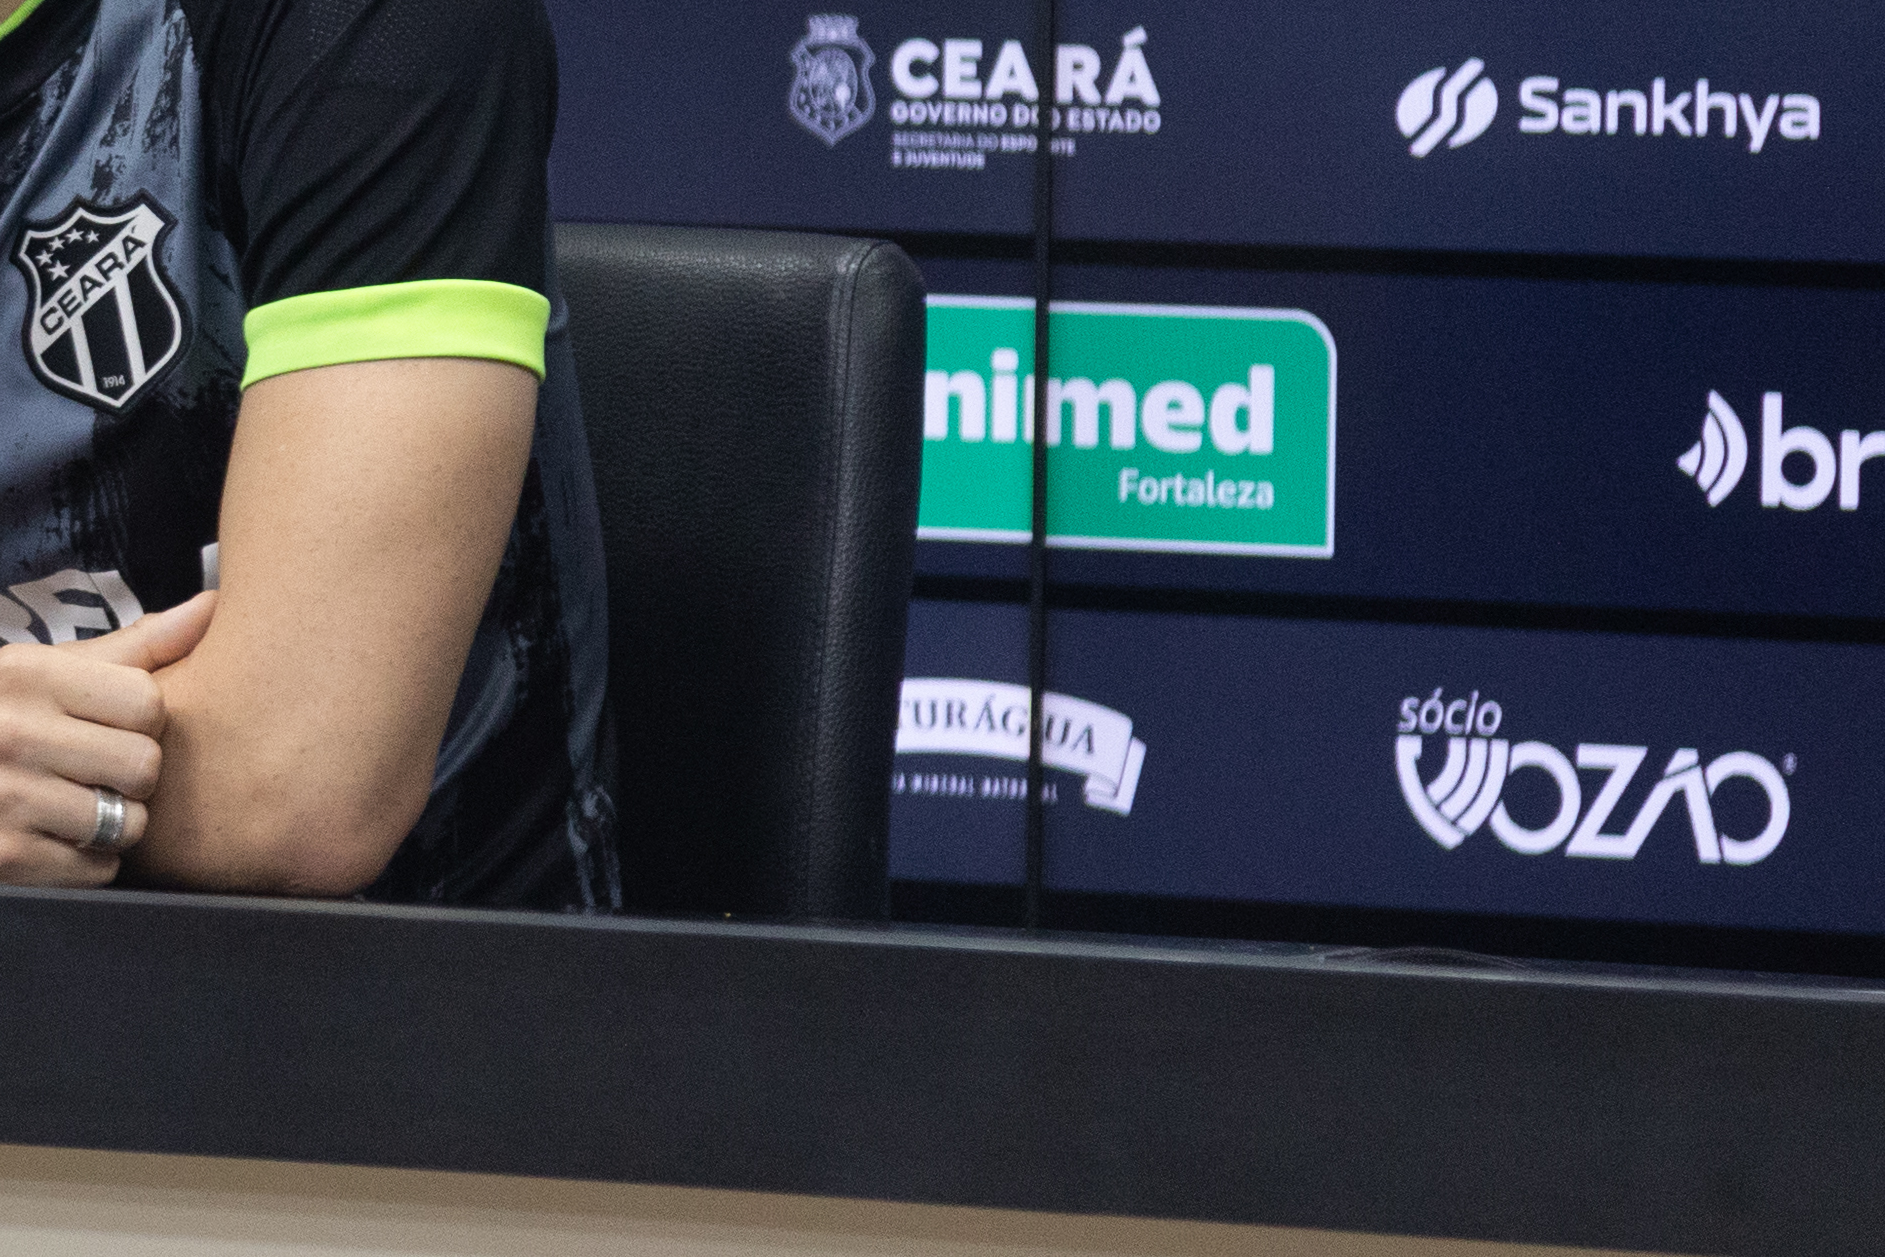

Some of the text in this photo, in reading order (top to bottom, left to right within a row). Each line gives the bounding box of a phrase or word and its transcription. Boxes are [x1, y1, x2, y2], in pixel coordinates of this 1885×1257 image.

[891, 26, 1161, 108] CEARÁ
[891, 100, 1008, 127] GOVERNO
[1066, 107, 1161, 134] ESTADO
[1518, 76, 1820, 153] Sankhya
[39, 224, 148, 336] CEARÁ
[924, 347, 1275, 455] nimed
[1119, 468, 1274, 509] Fortaleza
[905, 693, 1096, 755] URÁGUA
[1398, 688, 1502, 734] sócio
